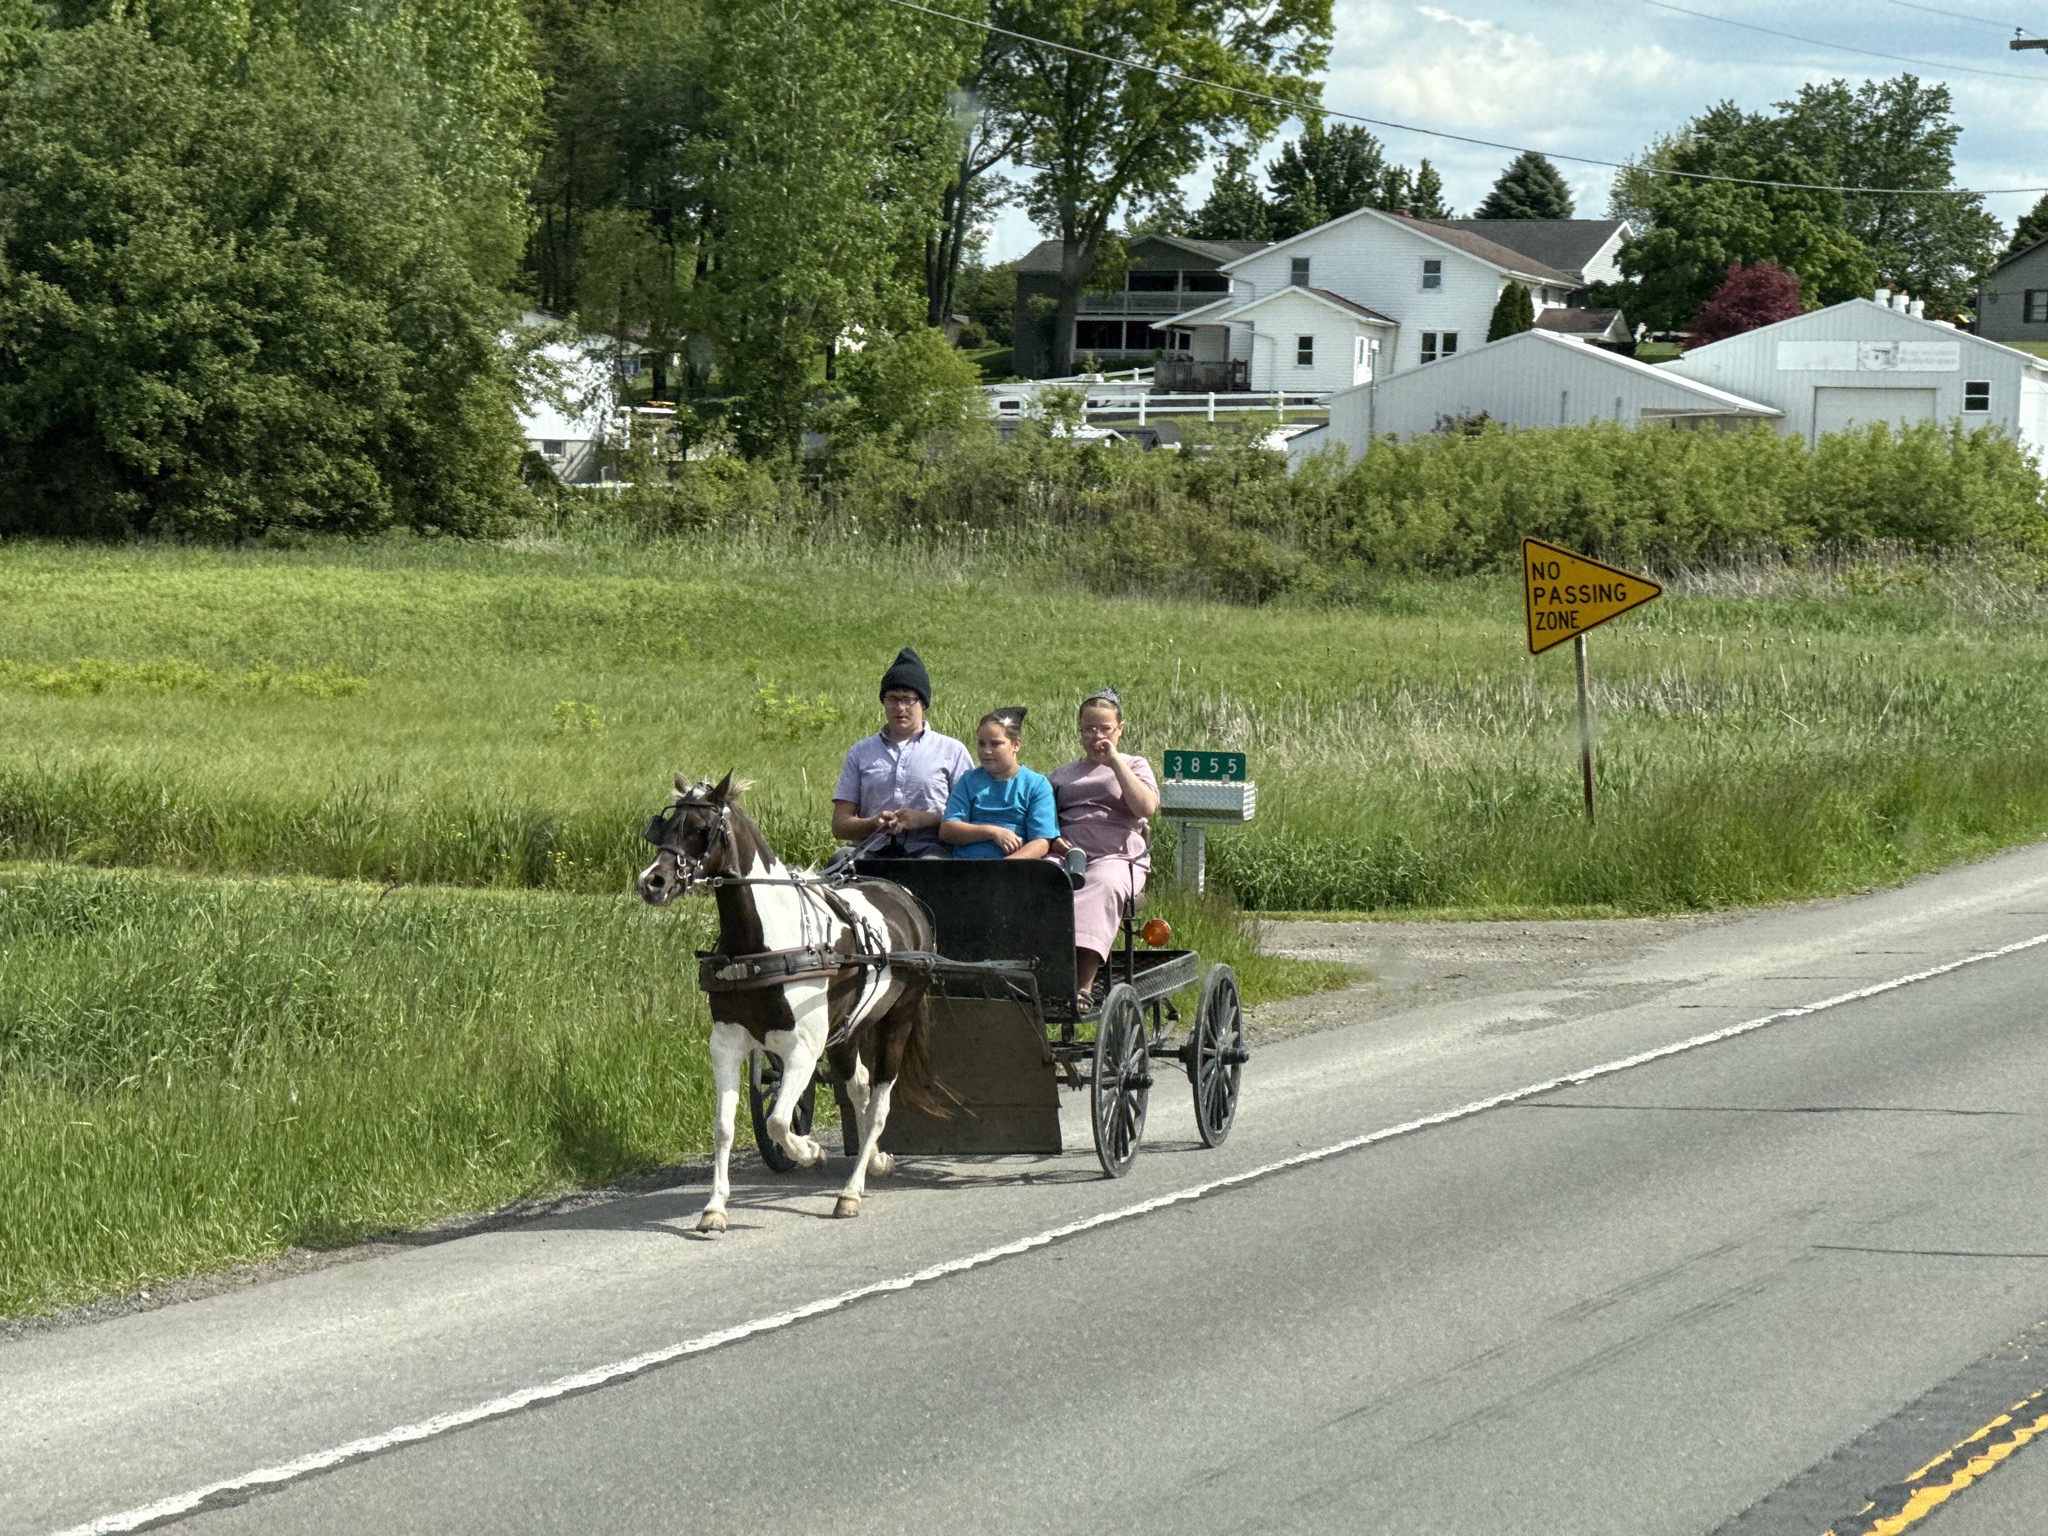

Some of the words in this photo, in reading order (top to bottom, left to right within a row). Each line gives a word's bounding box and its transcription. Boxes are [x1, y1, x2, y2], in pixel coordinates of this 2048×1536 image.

[1531, 561, 1561, 581] NO
[1533, 583, 1627, 606] PASSING
[1535, 610, 1581, 631] ZONE
[1173, 756, 1237, 774] 3855
